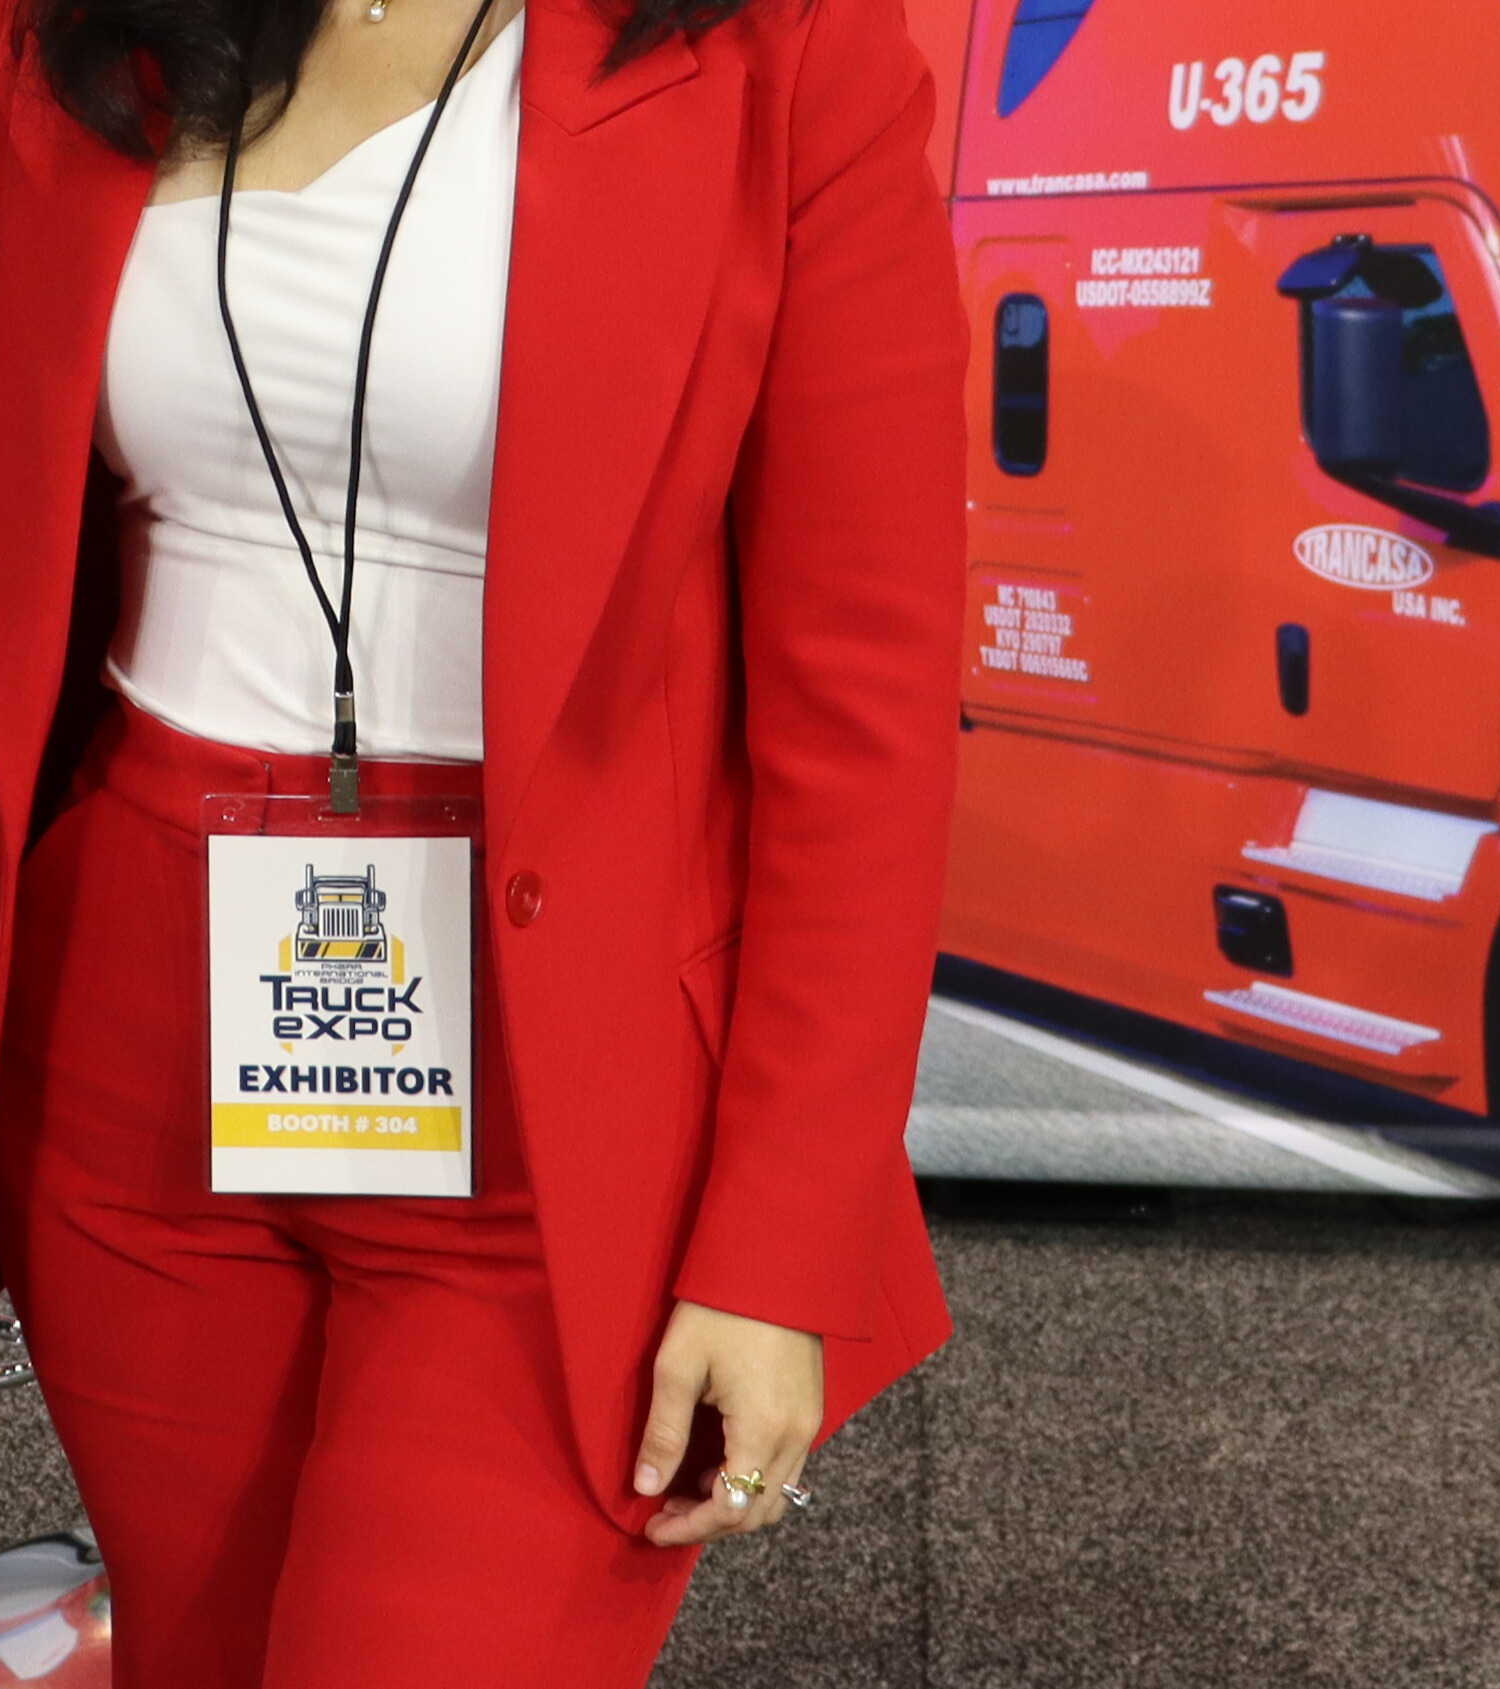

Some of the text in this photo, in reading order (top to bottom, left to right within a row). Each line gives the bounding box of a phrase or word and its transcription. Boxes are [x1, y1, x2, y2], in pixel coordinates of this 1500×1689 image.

[1168, 51, 1325, 131] U-365
[986, 171, 1149, 196] www.trancasa.com
[1300, 530, 1425, 583] TRANCASA
[1392, 589, 1427, 619] USA
[259, 975, 424, 1013] TRUCK
[238, 1064, 454, 1096] EXHIBITOR
[268, 1114, 418, 1135] BOOTH # 304
